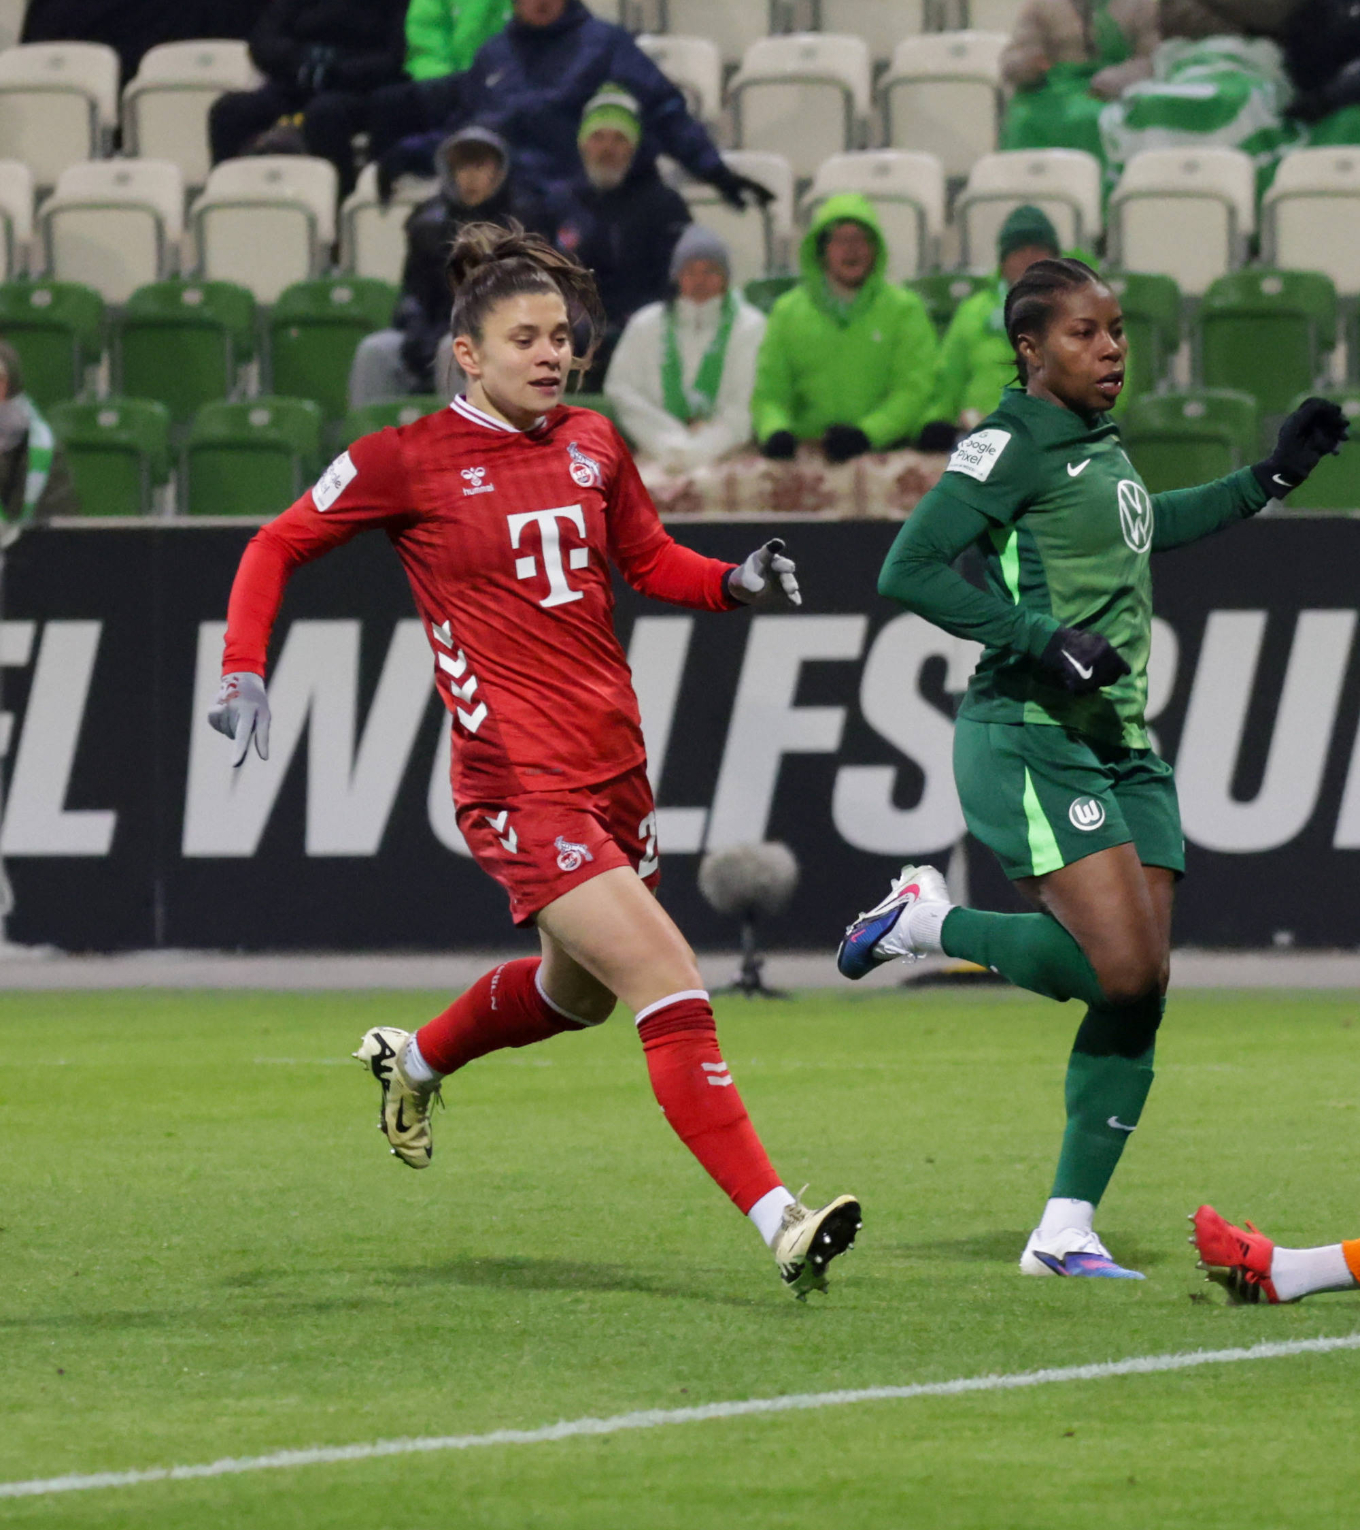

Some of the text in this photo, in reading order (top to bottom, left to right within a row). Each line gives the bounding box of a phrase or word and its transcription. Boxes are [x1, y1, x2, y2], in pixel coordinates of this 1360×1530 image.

[960, 440, 997, 456] oogle
[957, 449, 983, 466] Pixel
[462, 482, 495, 496] hummel
[507, 504, 589, 608] T
[0, 618, 118, 857] L
